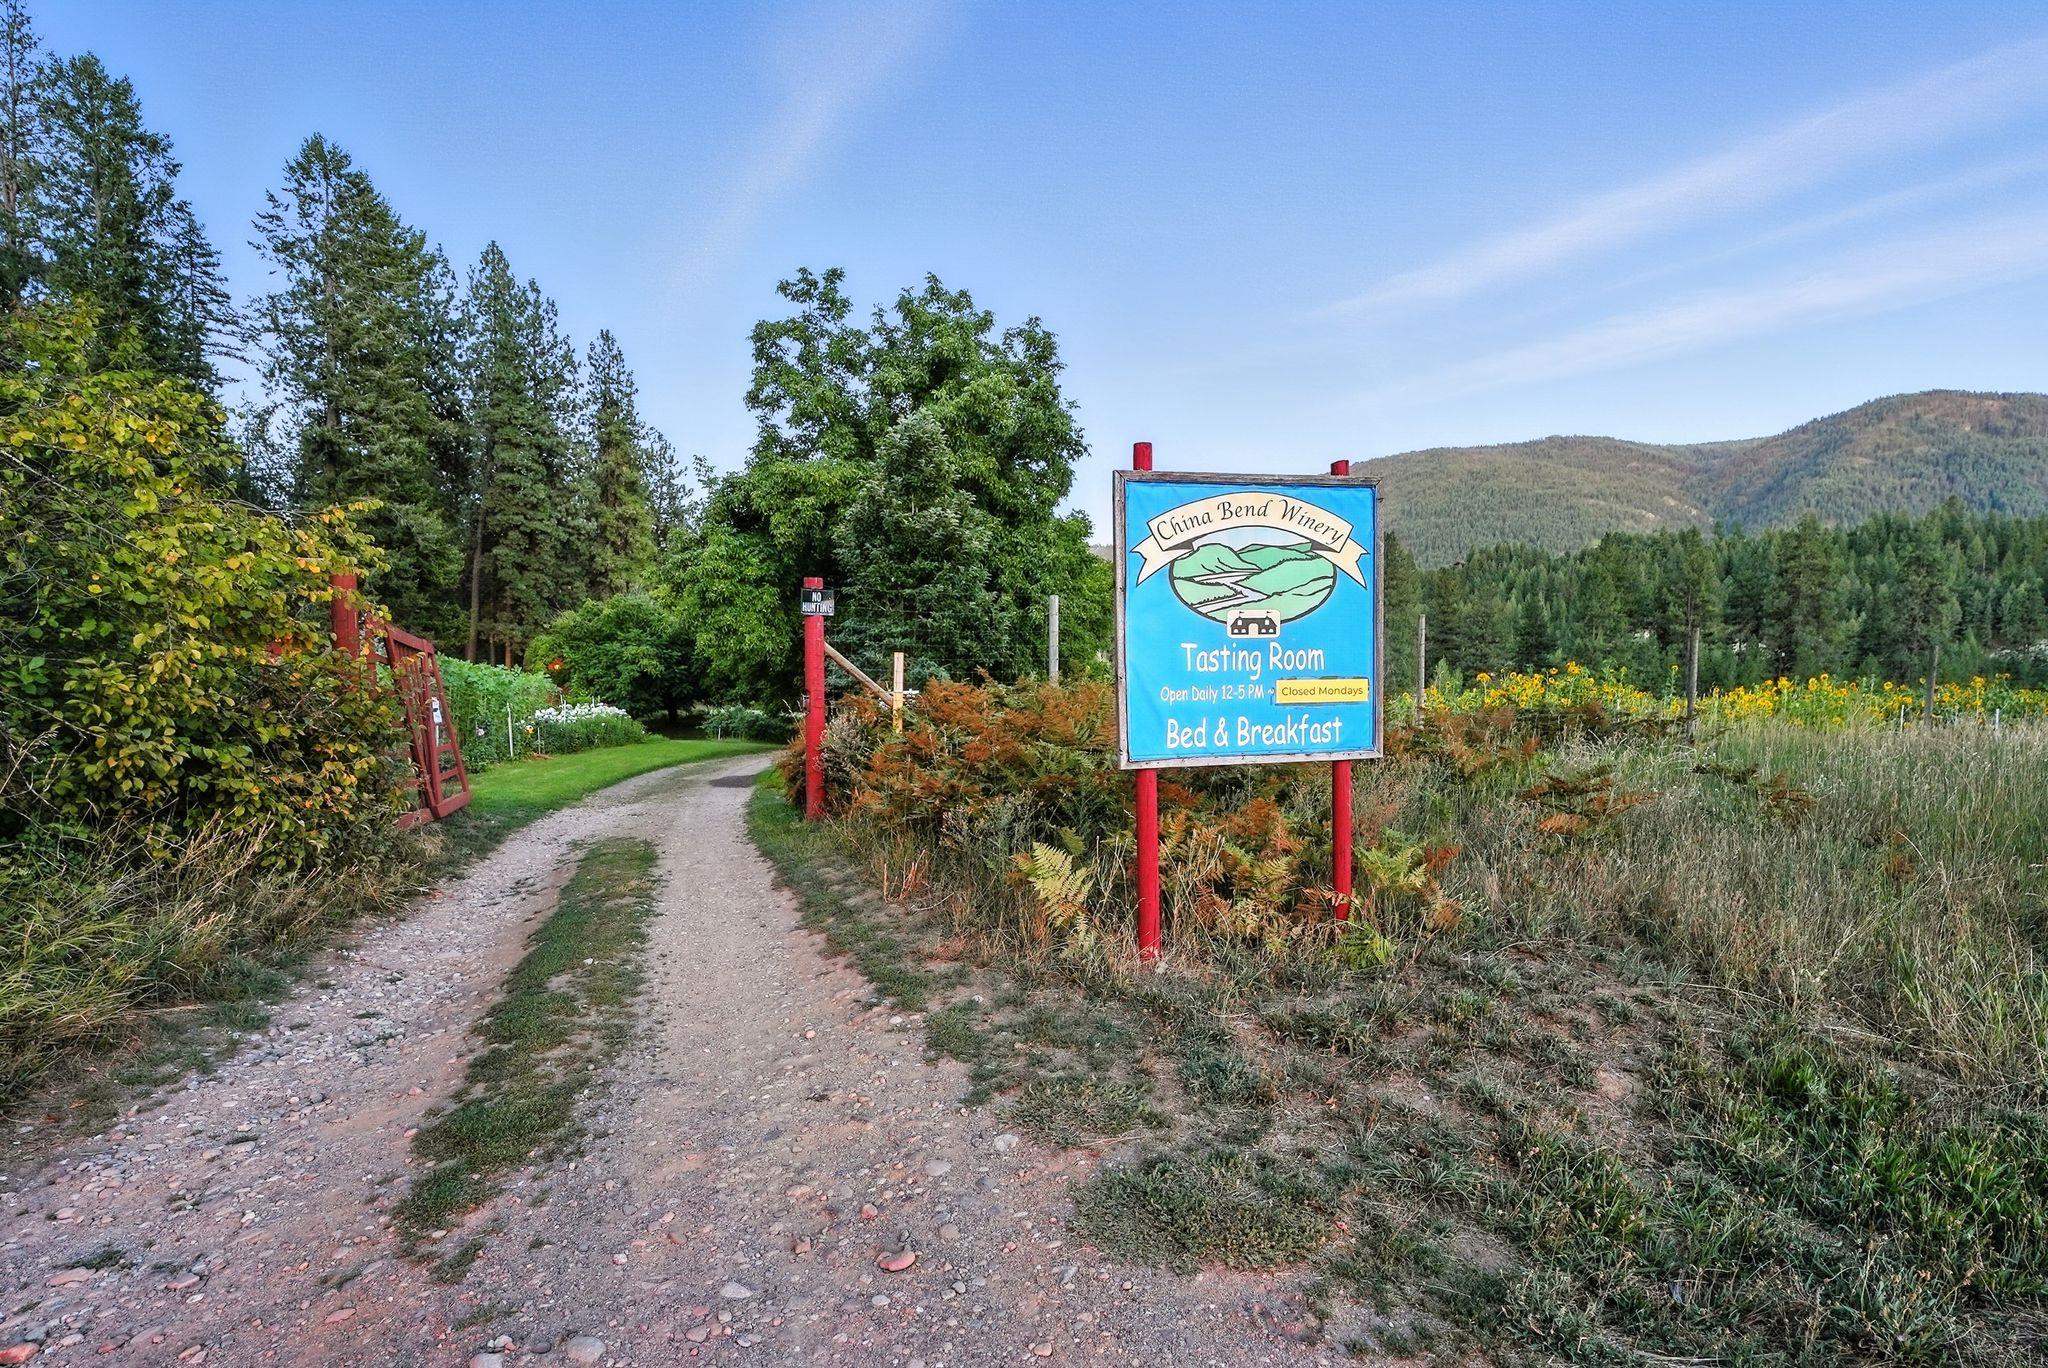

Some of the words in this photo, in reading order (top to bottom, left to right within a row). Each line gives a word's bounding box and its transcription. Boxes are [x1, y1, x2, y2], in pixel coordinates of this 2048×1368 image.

[1156, 510, 1213, 541] China
[1216, 499, 1274, 521] Bend
[1279, 499, 1346, 545] Winery
[802, 602, 833, 613] HUNTING
[811, 591, 822, 602] NO
[1180, 642, 1262, 680] Tasting
[1269, 641, 1326, 672] Room
[1160, 686, 1189, 706] Open
[1191, 685, 1218, 705] Daily
[1248, 684, 1265, 699] PM
[1281, 686, 1316, 697] Closed
[1318, 685, 1364, 697] Mondays
[1166, 717, 1207, 749] Bed
[1214, 716, 1229, 748] &
[1236, 713, 1343, 748] Breakfast
